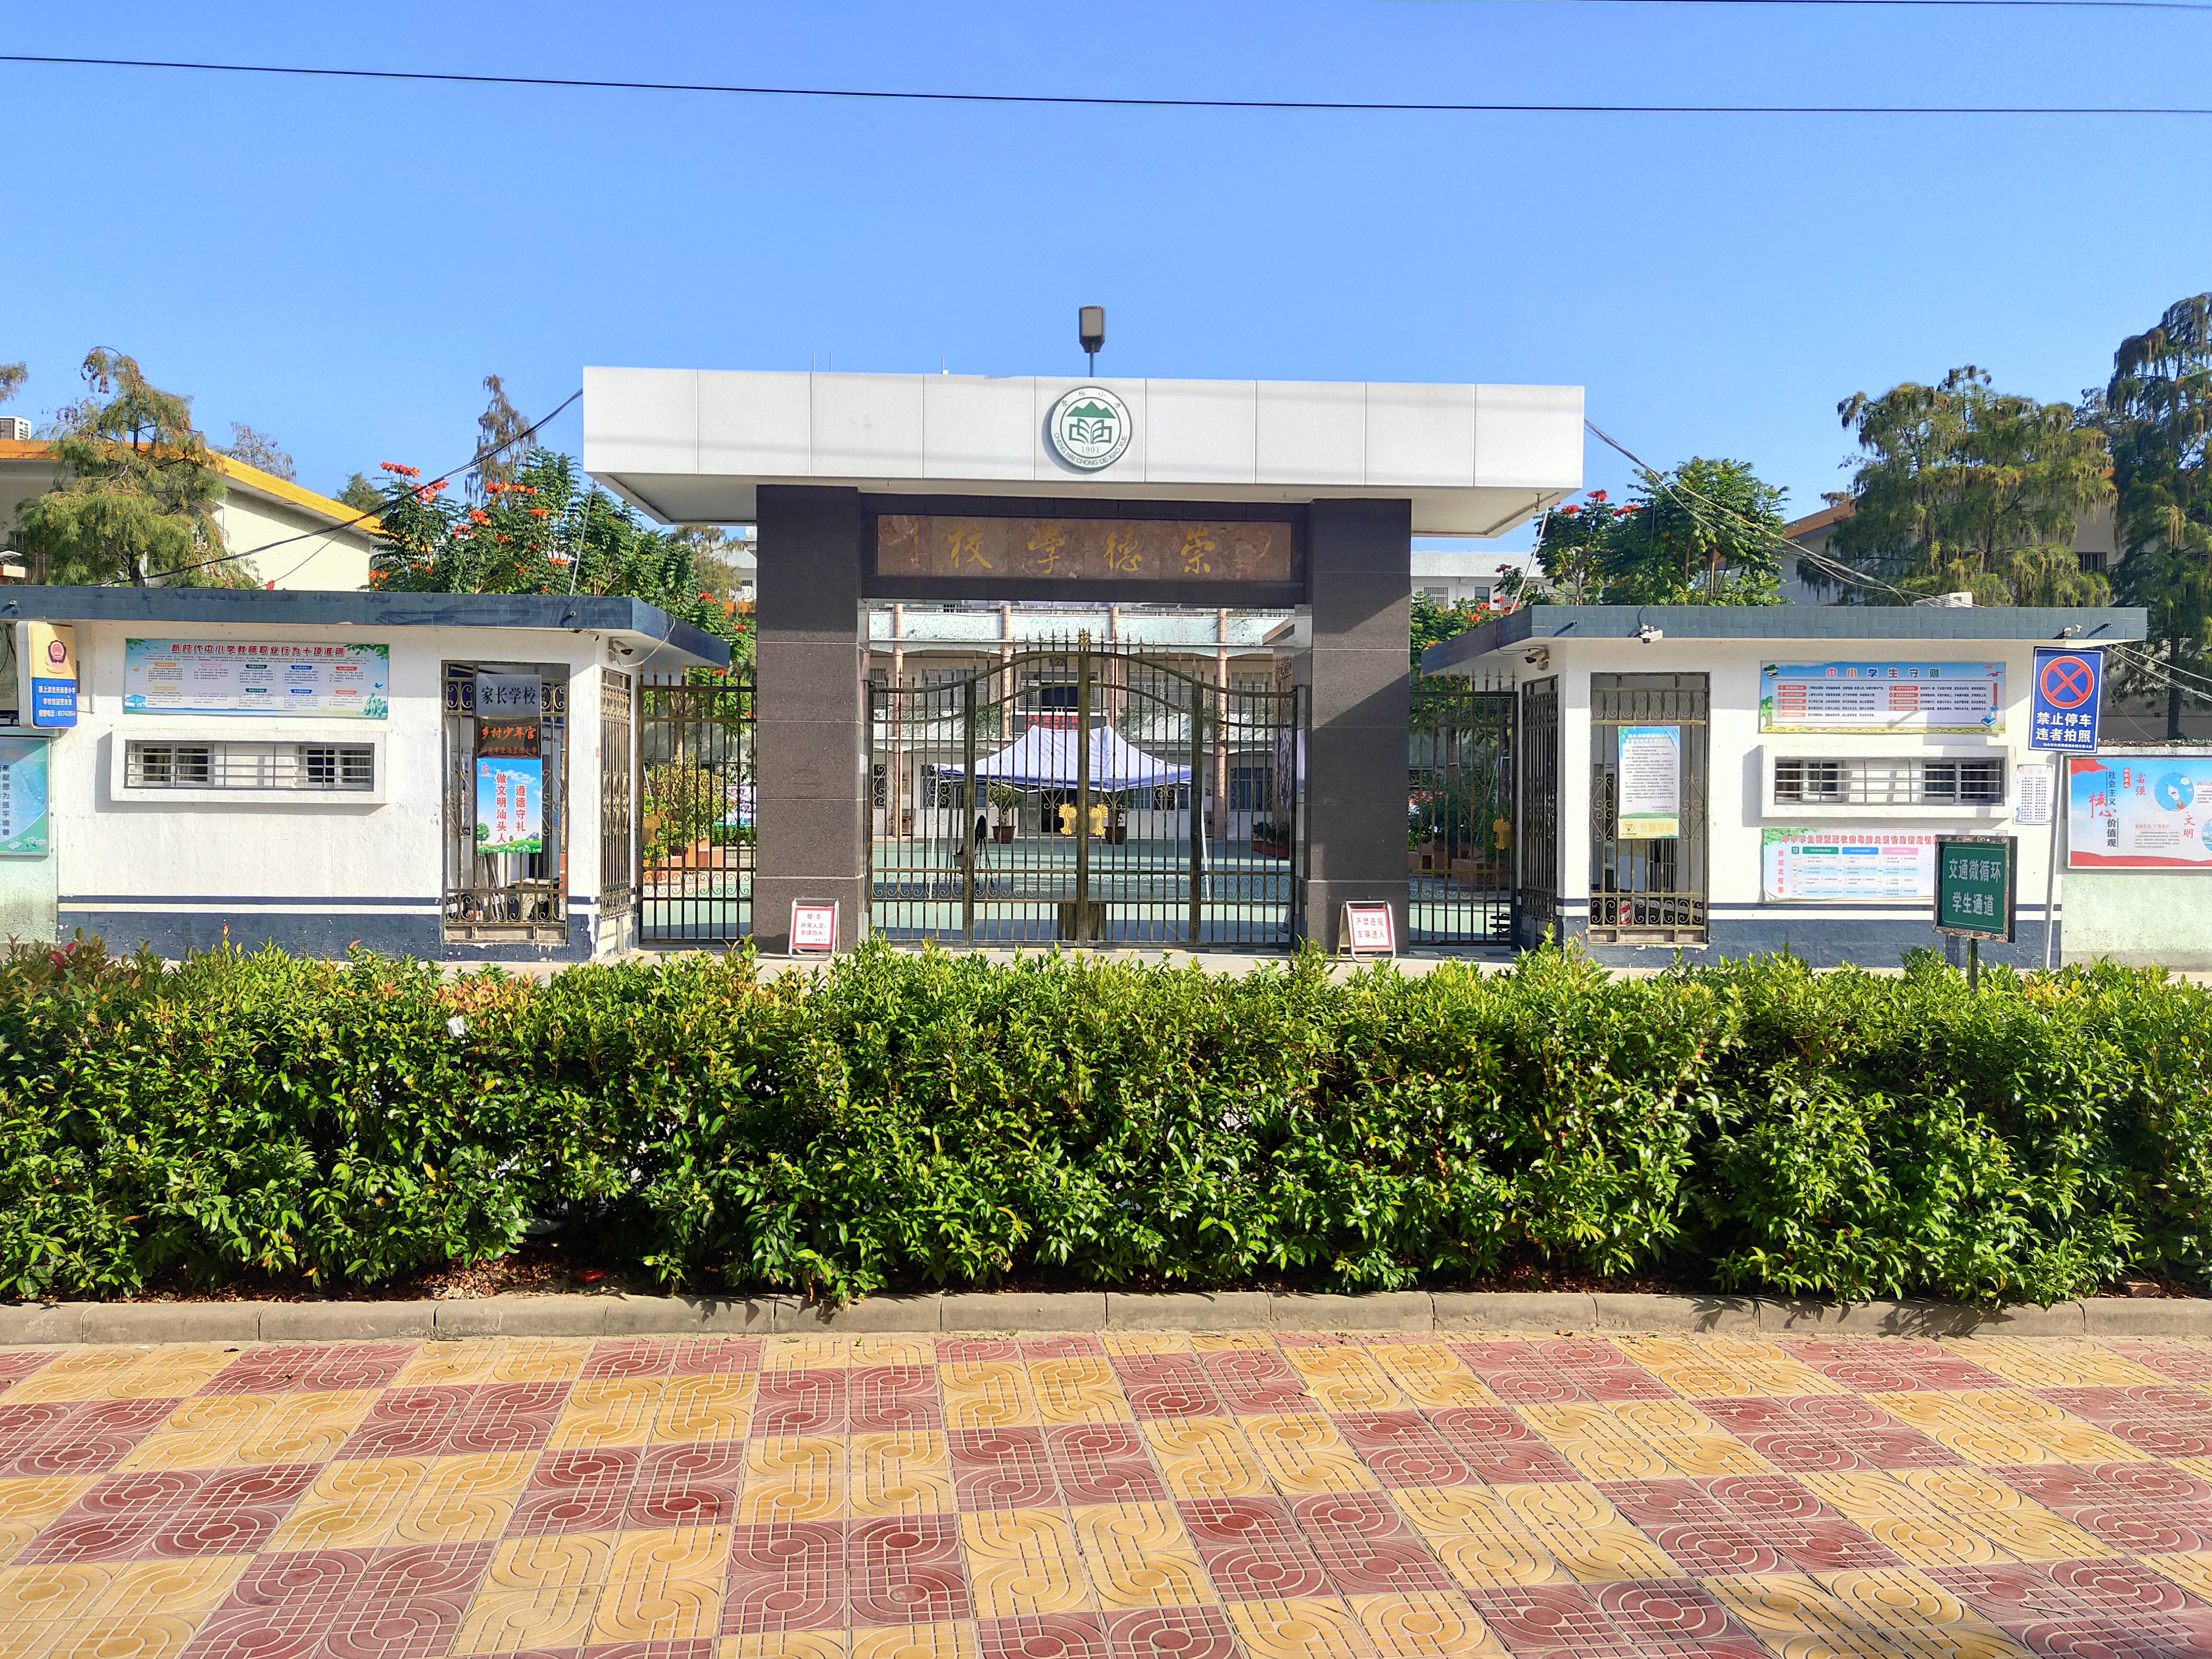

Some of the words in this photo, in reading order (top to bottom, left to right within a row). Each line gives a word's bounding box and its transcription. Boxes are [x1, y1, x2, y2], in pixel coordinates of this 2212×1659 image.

[1054, 433, 1066, 454] CHENG
[1065, 450, 1076, 461] HAI
[1108, 447, 1121, 461] XIAO
[1118, 434, 1128, 448] XUE
[171, 644, 345, 656] 新时代中小学教师职业行为十项准则
[1826, 668, 1939, 678] 中小学生守则
[481, 686, 536, 705] 家长学校
[2036, 711, 2092, 727] 禁止停车
[481, 726, 537, 740] 乡村少年宫
[2035, 728, 2091, 743] 违者拍照
[2108, 771, 2116, 805] 社会主义
[2136, 772, 2146, 795] 富强
[495, 773, 507, 843] 做文明汕头人
[515, 785, 526, 832] 遵德守礼
[2088, 792, 2117, 818] 核心
[2106, 818, 2116, 847] 价值观
[2183, 812, 2196, 839] 文明
[1948, 858, 2001, 883] 交通微循环
[1952, 891, 1994, 916] 学生通道
[1356, 917, 1384, 926] 严禁违规
[1358, 930, 1385, 938] 车辆进入
